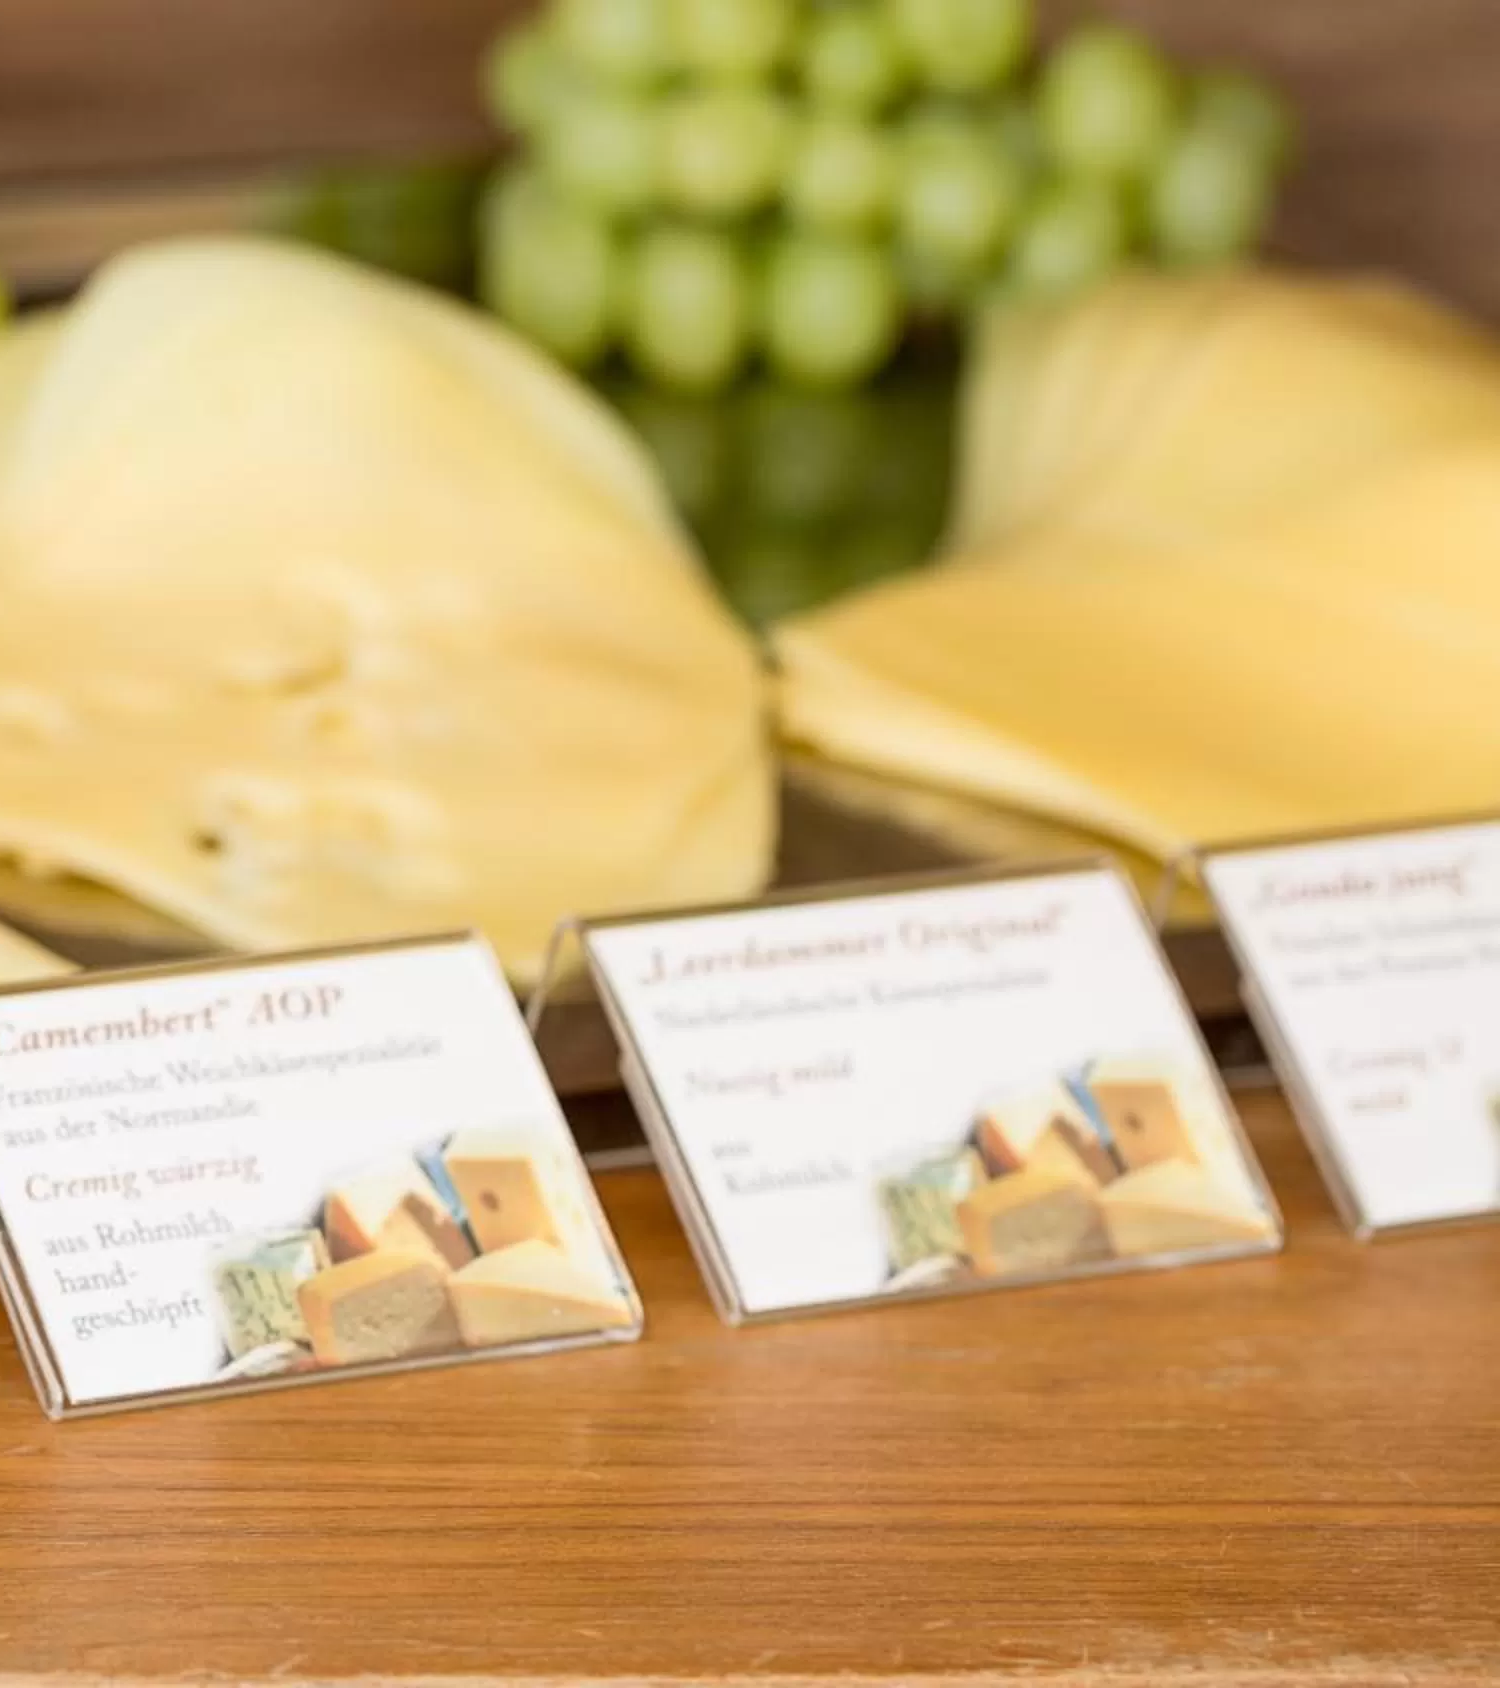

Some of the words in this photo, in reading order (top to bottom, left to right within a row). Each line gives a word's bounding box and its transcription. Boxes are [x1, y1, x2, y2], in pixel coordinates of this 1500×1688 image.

[247, 985, 345, 1025] AOP
[3, 1122, 49, 1149] aus
[55, 1110, 99, 1143] der
[107, 1094, 259, 1135] Normandie
[24, 1161, 140, 1204] Cremig
[150, 1146, 264, 1186] würzig
[43, 1234, 90, 1258] aus
[96, 1209, 234, 1252] Rohmilch
[57, 1264, 139, 1299] hand-
[71, 1294, 208, 1342] geschöpft
